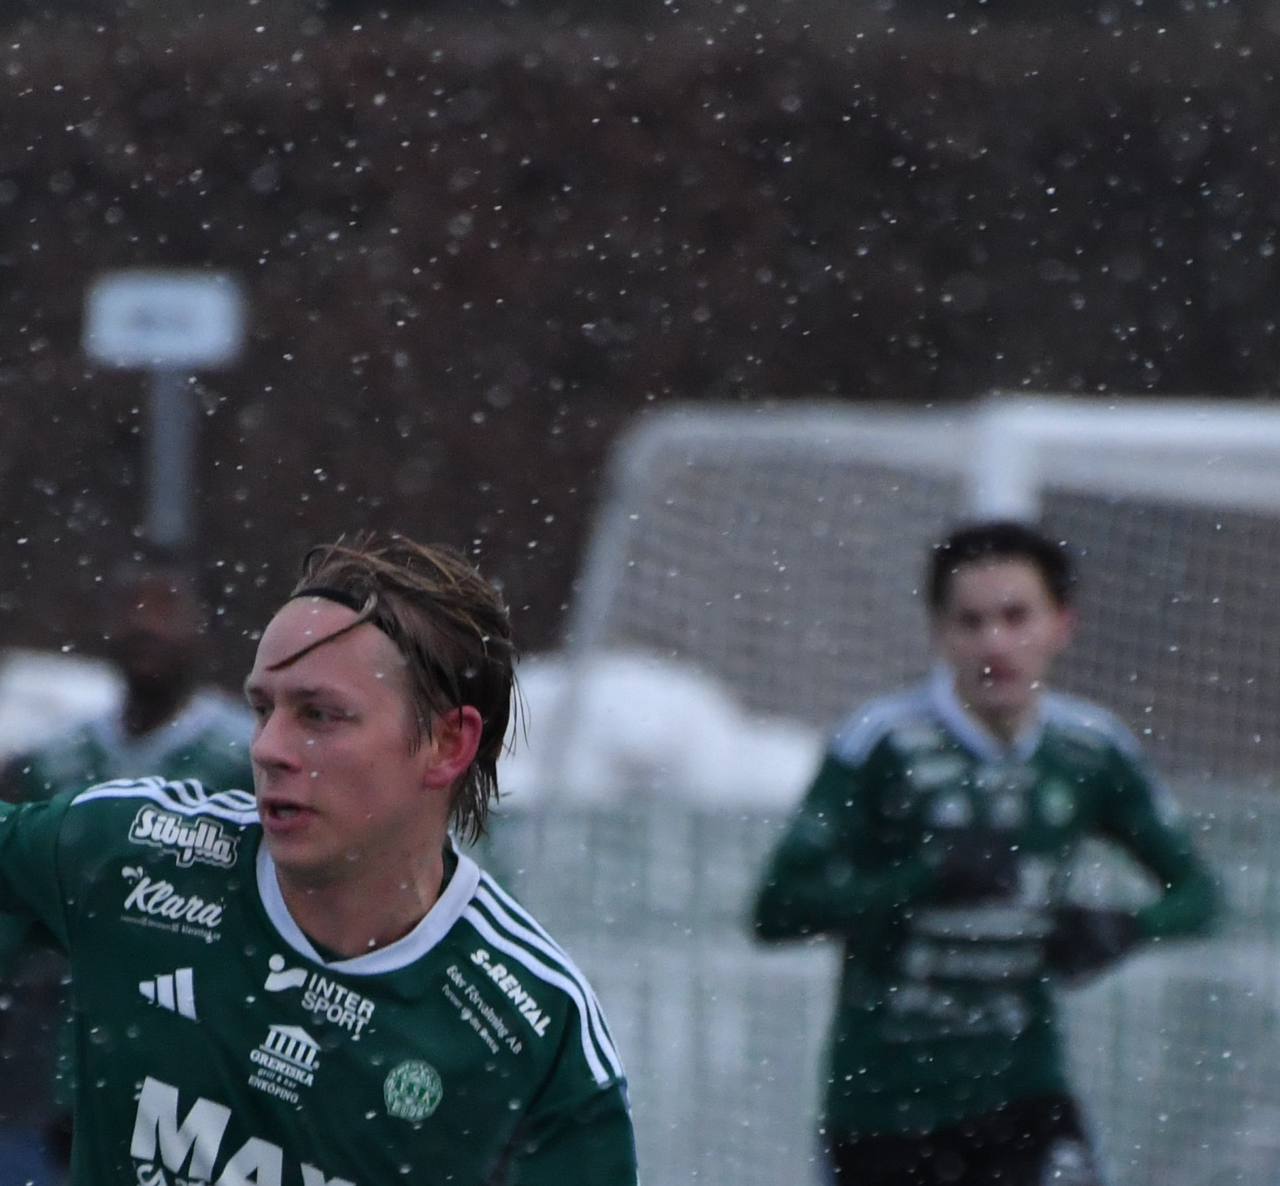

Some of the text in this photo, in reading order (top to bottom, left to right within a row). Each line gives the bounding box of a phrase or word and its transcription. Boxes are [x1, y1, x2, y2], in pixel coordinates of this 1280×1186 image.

[134, 808, 233, 863] Sibylla
[123, 874, 223, 929] Klara
[301, 990, 370, 1034] SPORT
[307, 972, 376, 1020] INTER
[470, 948, 553, 1038] S-RENTAL
